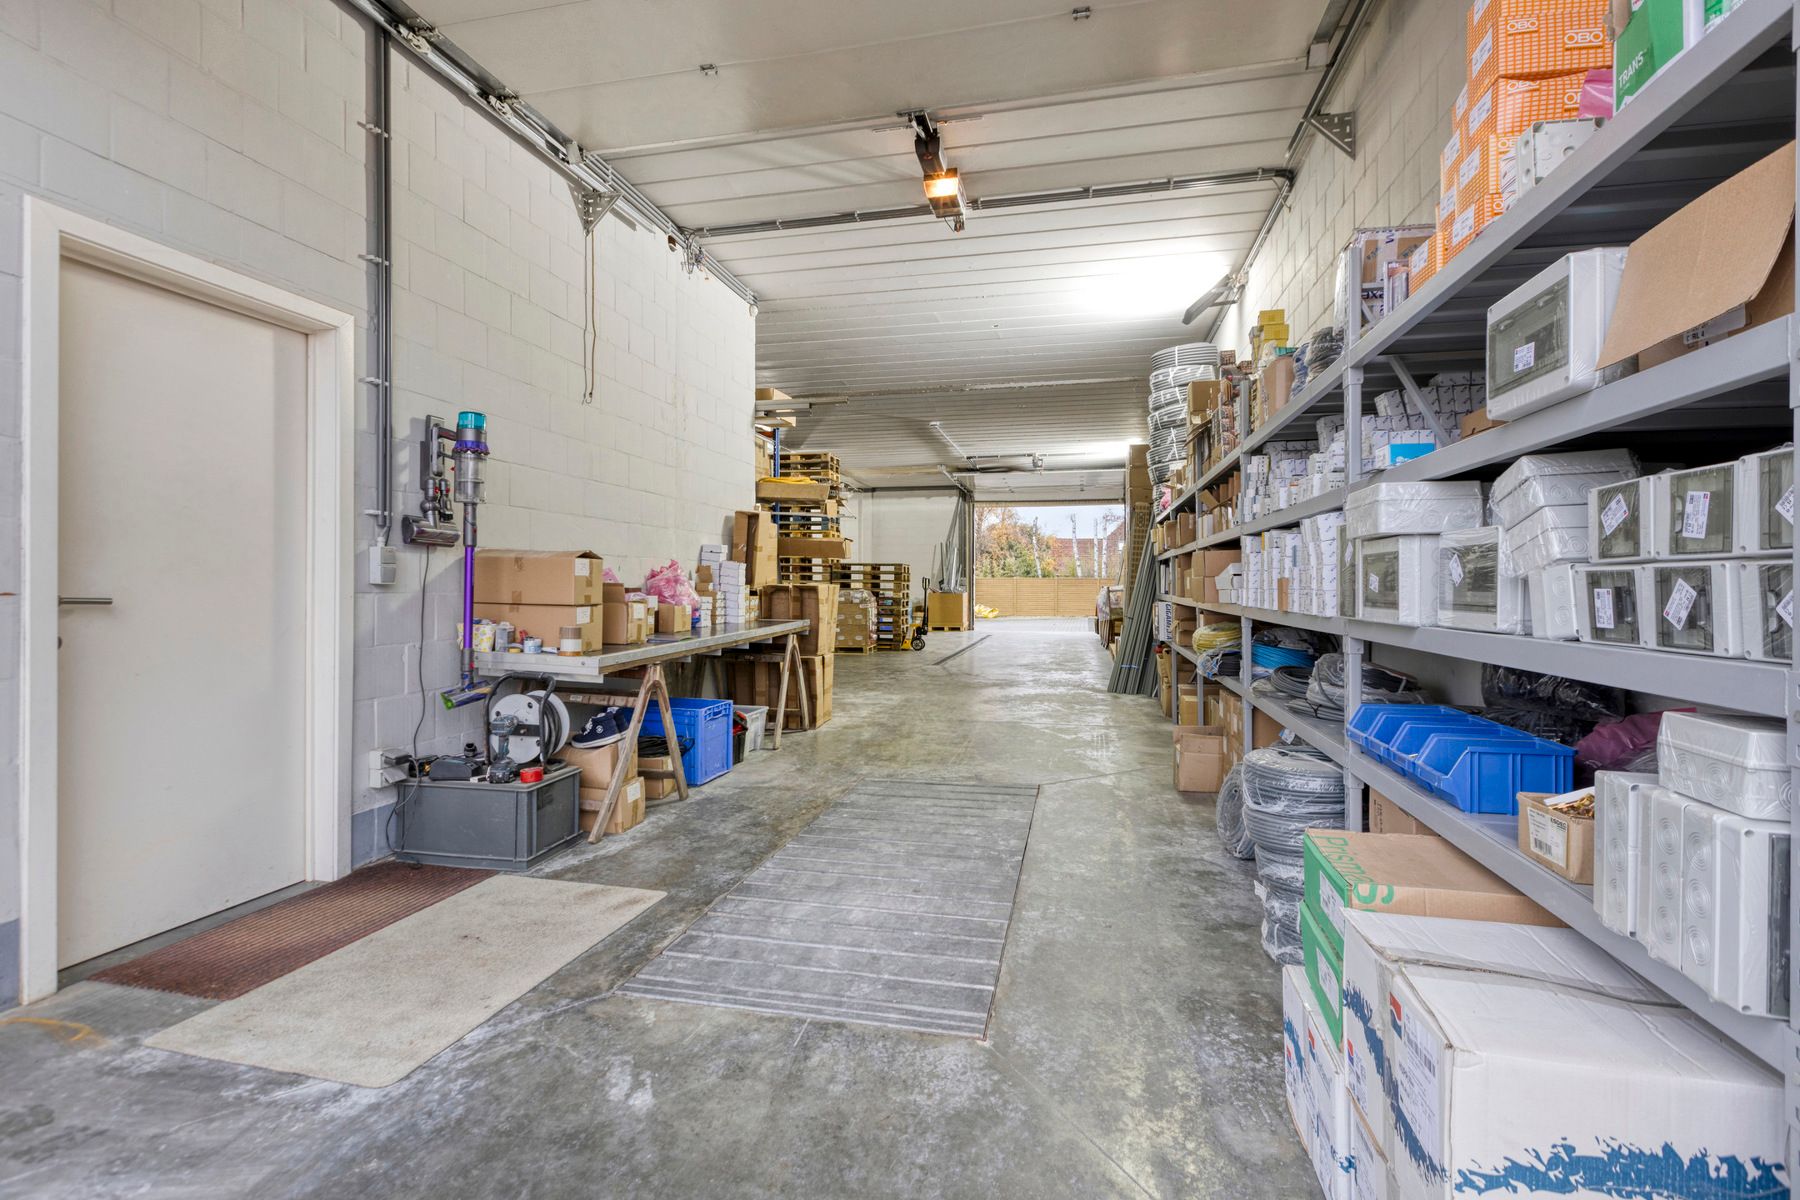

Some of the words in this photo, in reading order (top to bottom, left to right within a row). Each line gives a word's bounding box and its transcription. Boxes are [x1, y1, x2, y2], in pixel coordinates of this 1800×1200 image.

[1507, 20, 1538, 31] OBO
[1564, 31, 1603, 44] OBO
[1618, 51, 1645, 88] TRANS
